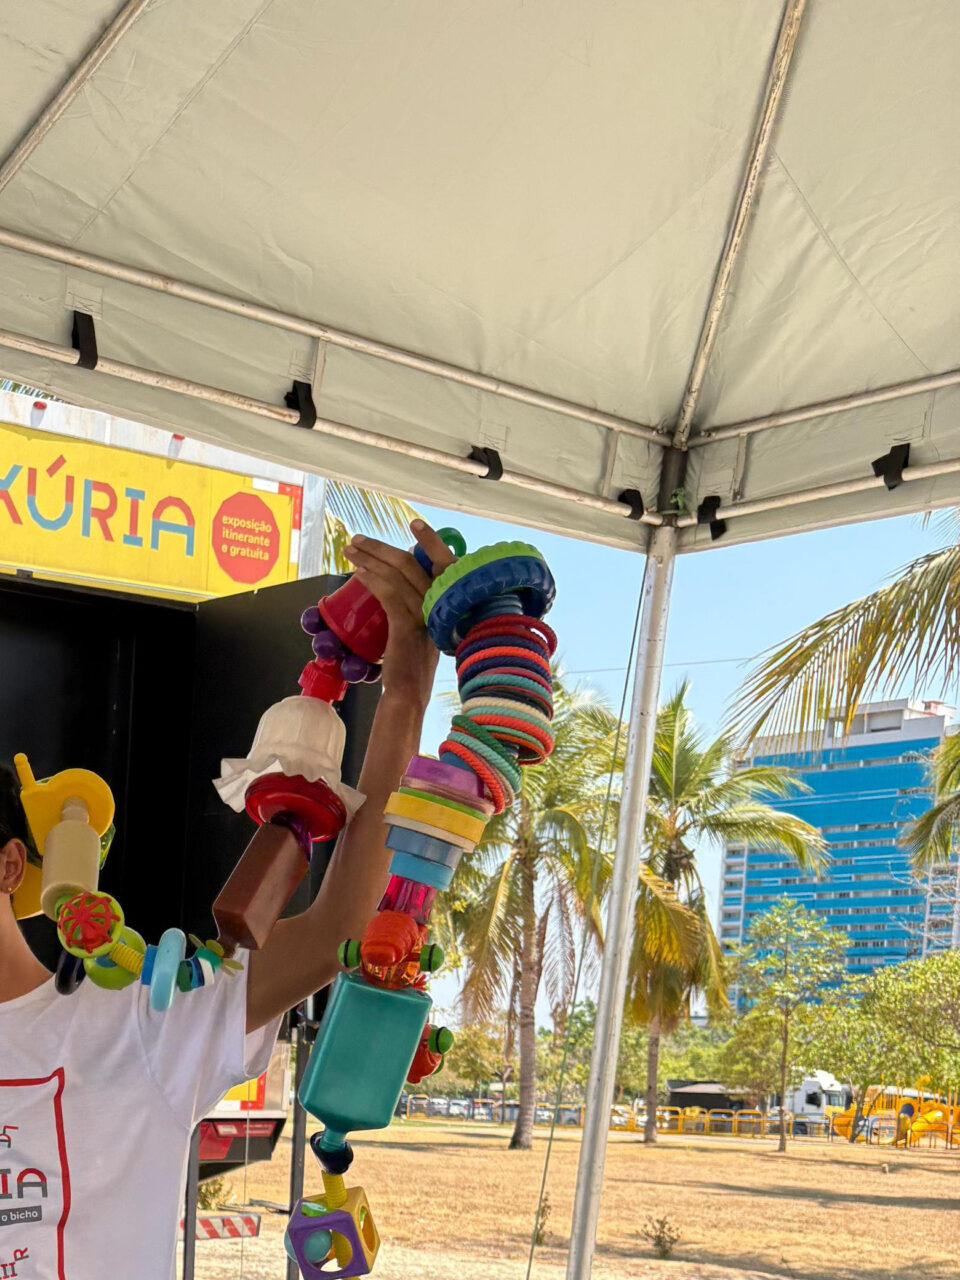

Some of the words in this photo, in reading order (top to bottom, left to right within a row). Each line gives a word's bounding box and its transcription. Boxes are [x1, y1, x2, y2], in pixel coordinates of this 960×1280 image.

[222, 515, 272, 533] exposição
[222, 527, 271, 547] itinerante
[221, 544, 228, 553] e
[230, 545, 269, 561] gratuita
[1, 1214, 8, 1222] o
[9, 1210, 38, 1221] bicho
